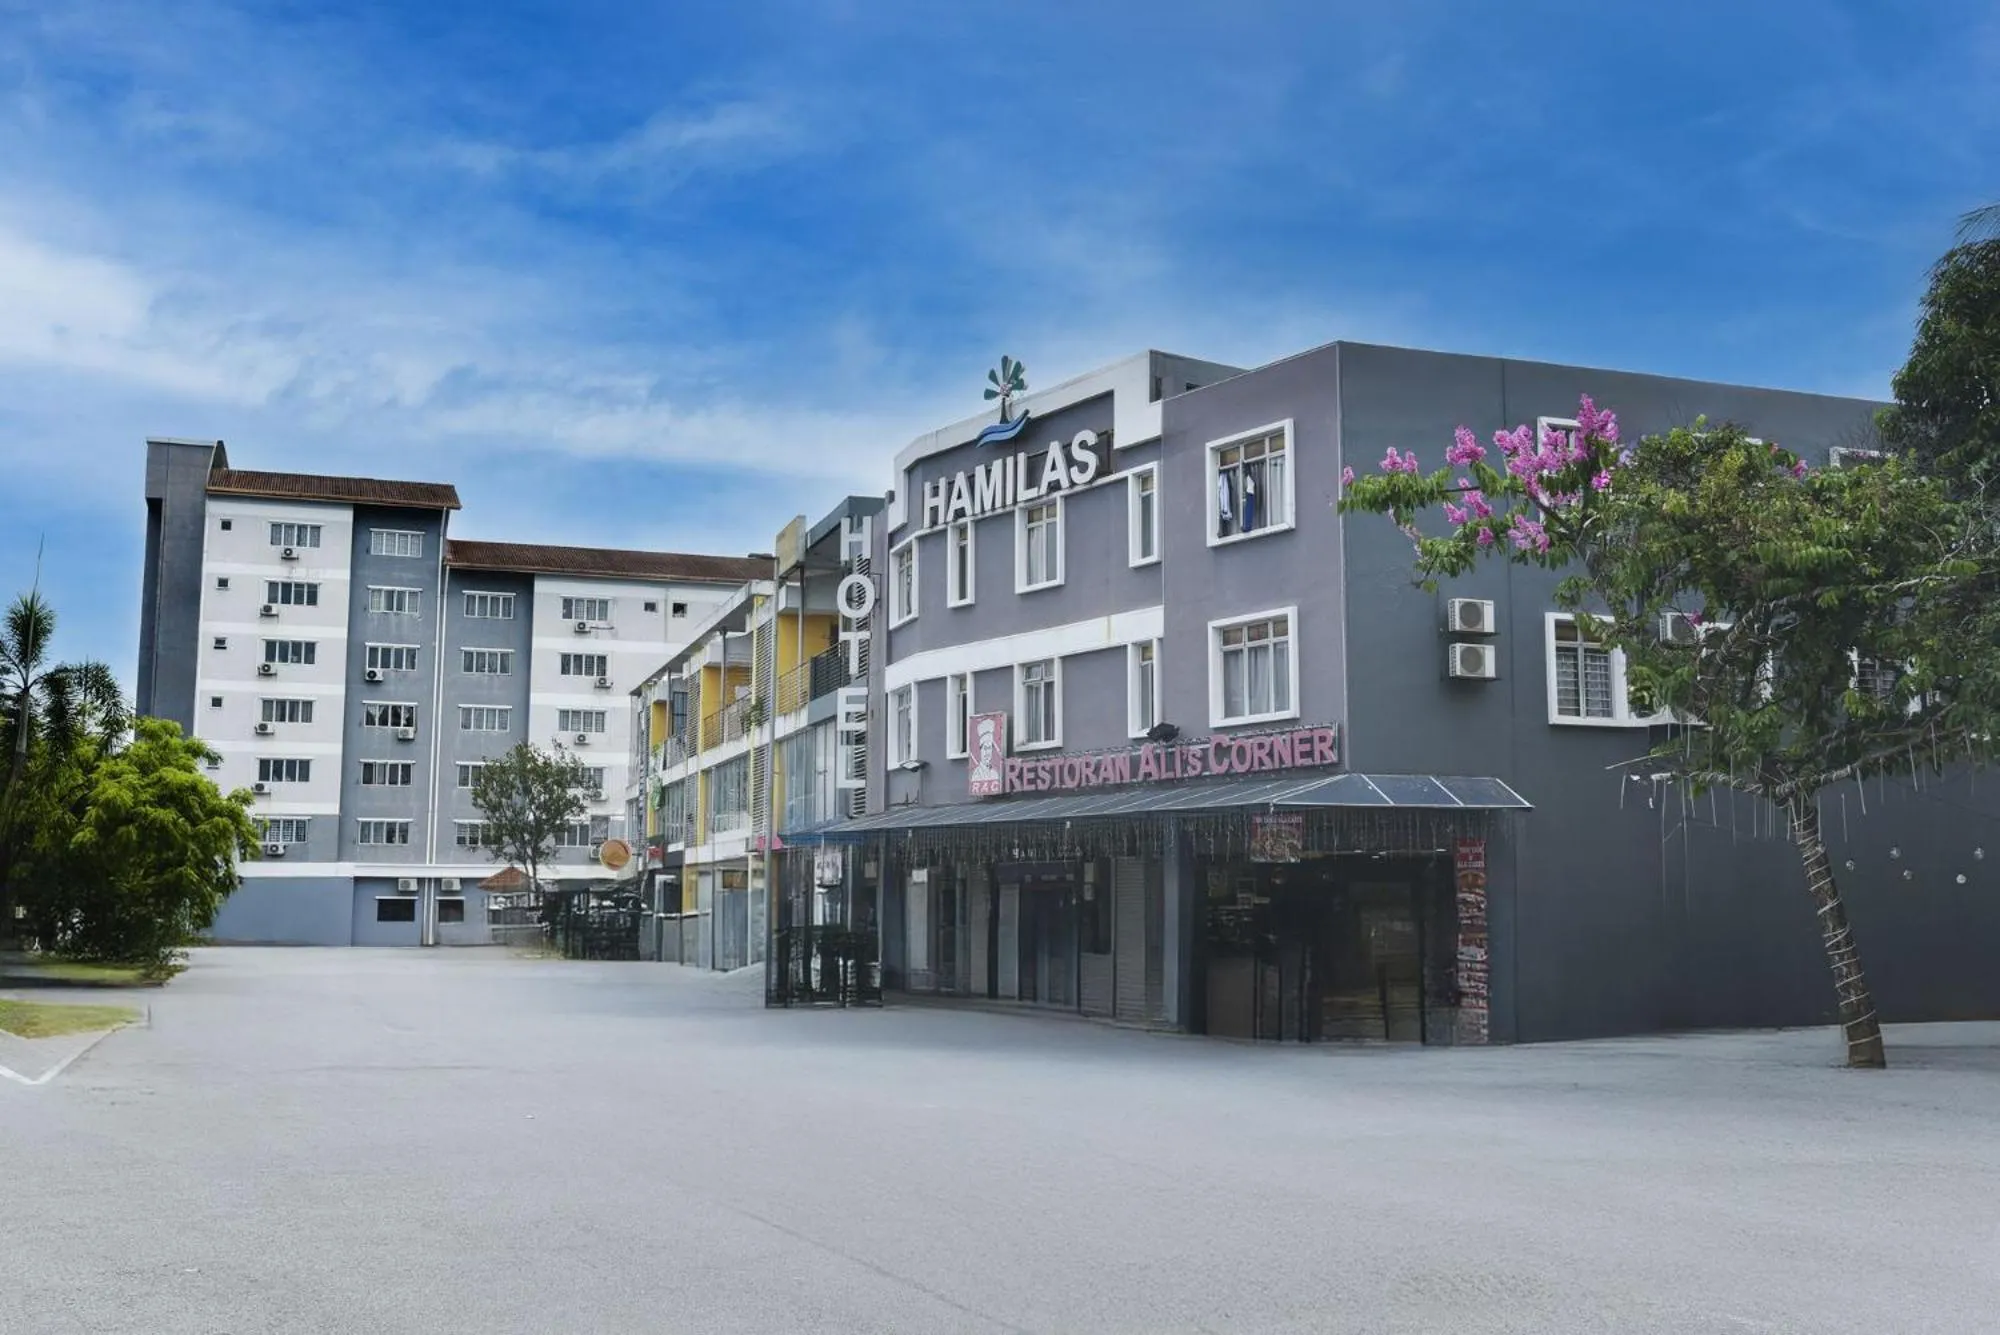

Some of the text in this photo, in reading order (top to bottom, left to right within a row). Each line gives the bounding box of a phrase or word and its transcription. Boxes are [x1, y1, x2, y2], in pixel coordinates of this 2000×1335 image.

[924, 429, 1099, 528] HAMILAS
[836, 515, 875, 788] HOTEL
[1004, 752, 1131, 793] RESTORAN
[1209, 728, 1334, 775] CORNER
